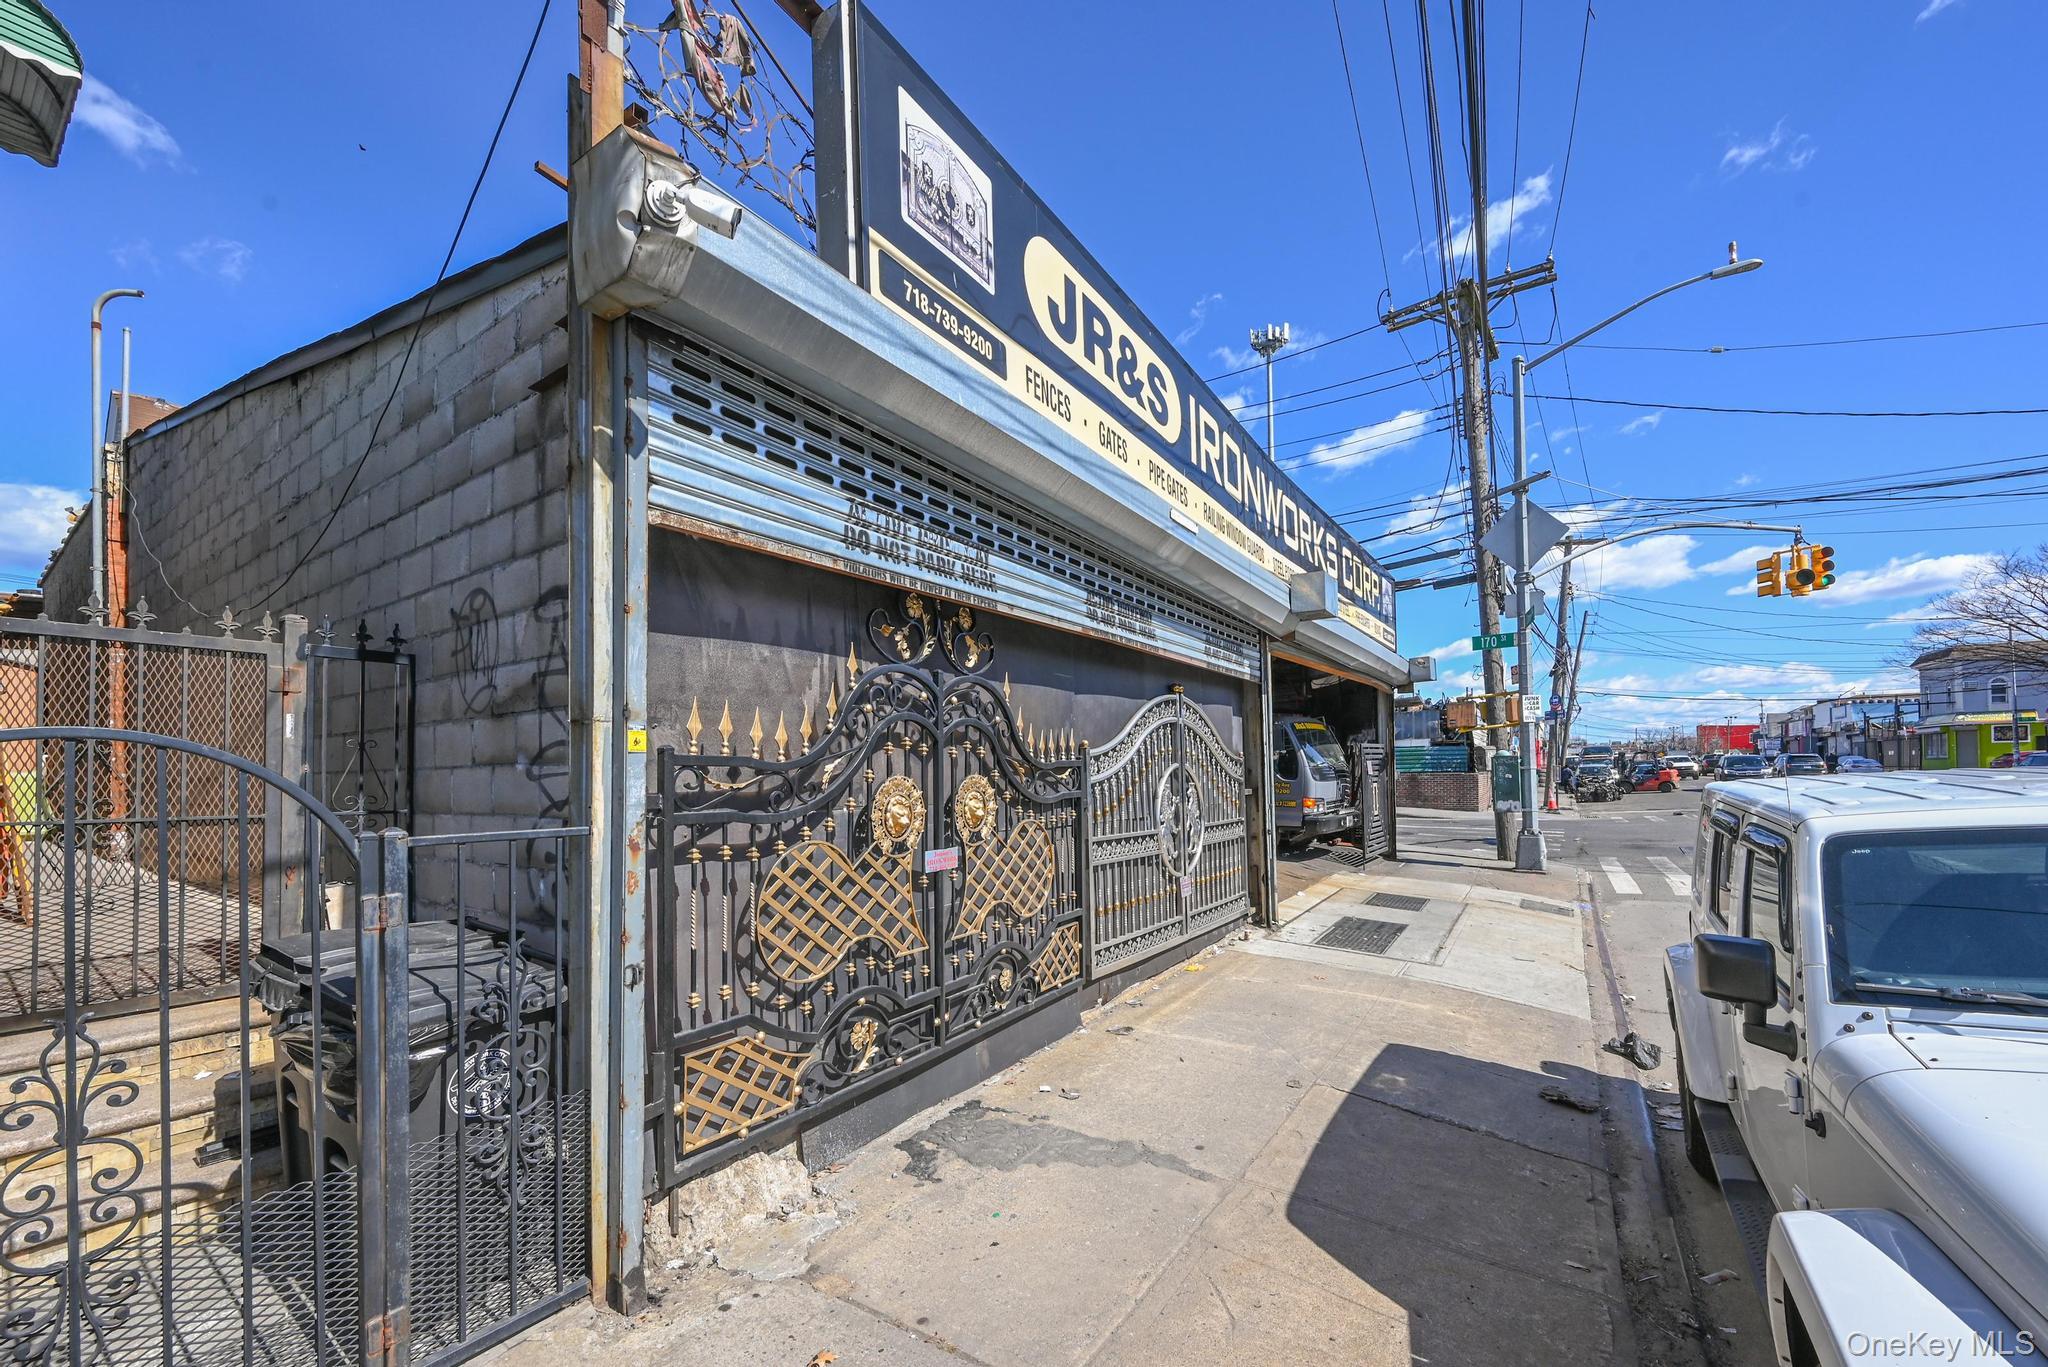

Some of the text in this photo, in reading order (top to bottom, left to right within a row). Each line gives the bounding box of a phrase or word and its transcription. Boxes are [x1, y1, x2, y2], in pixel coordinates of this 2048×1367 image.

[903, 279, 993, 361] 718-739-9200
[1025, 365, 1071, 423] FENCES
[1098, 421, 1128, 463] GATES
[1149, 459, 1166, 491] PIPE
[1166, 473, 1188, 507] GATES
[1203, 502, 1226, 535] RAILING
[1226, 519, 1247, 551] WINDOW
[1047, 273, 1169, 427] JR&S
[1189, 394, 1338, 580] IRONWORKS
[843, 523, 872, 555] DO
[876, 535, 911, 567] NOT
[843, 559, 998, 610] VIOLATORS WILL BE TOWED AT THEIR EXPENSE
[1481, 636, 1497, 648] 170
